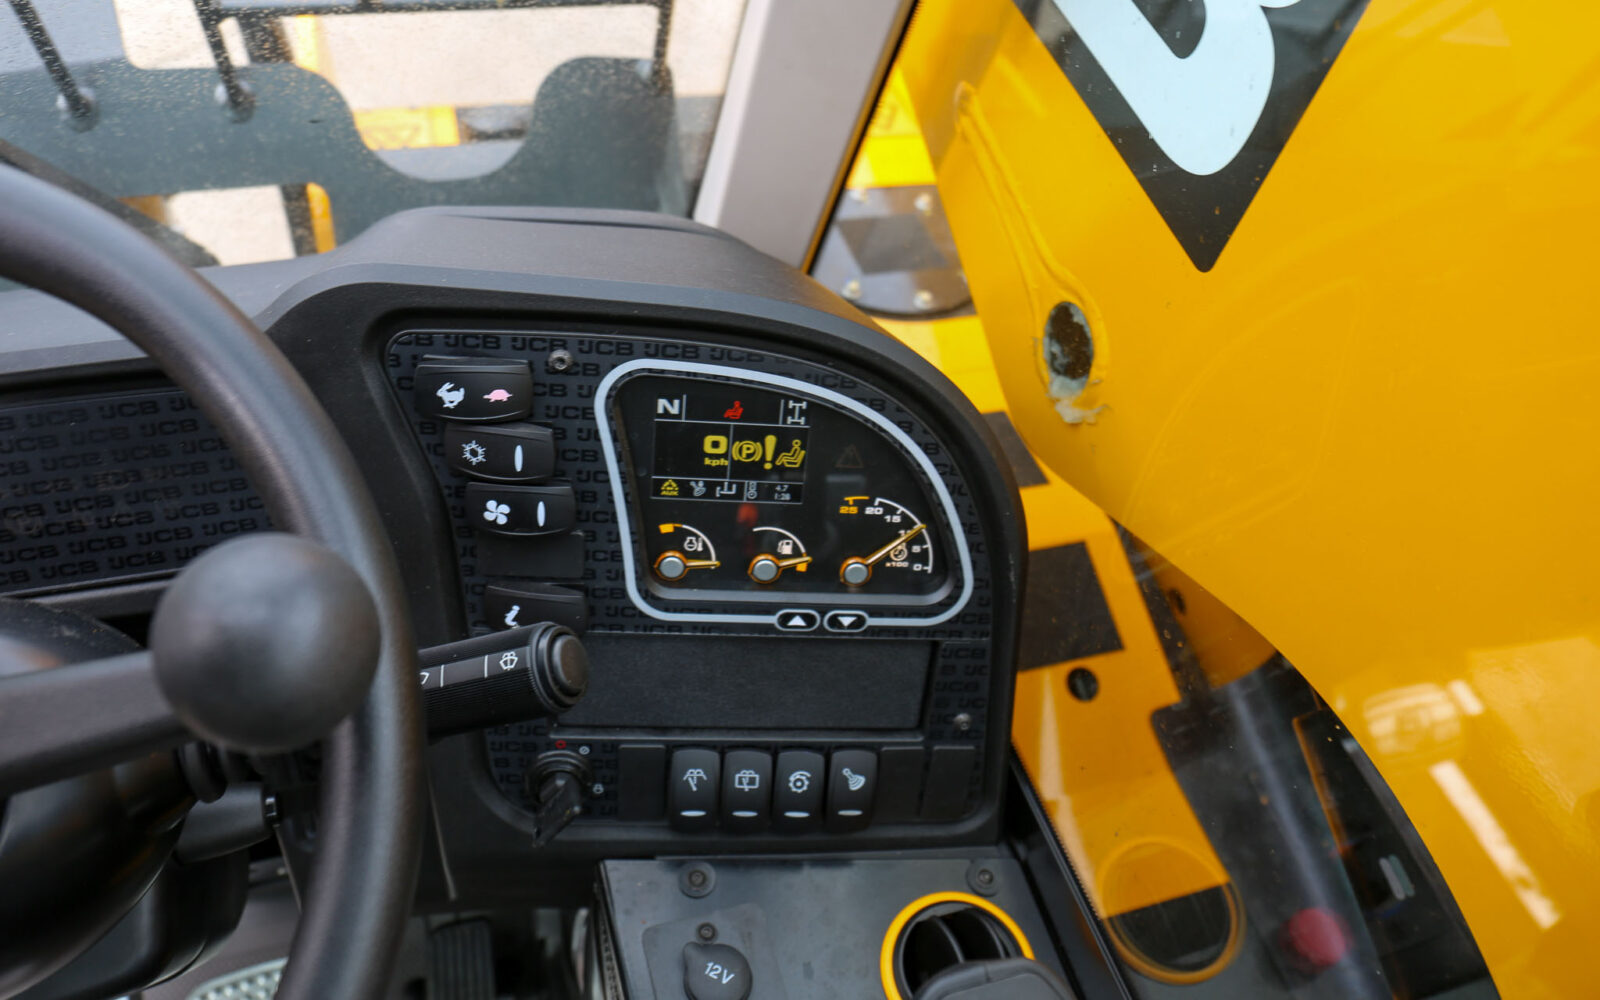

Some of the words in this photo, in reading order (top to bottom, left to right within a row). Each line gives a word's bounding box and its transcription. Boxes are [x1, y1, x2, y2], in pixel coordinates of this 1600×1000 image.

[443, 333, 501, 350] JCB
[511, 336, 569, 352] JCB
[577, 339, 635, 355] JCB
[645, 342, 699, 359] JCB
[532, 383, 569, 398] CB
[98, 400, 160, 420] JCB
[656, 399, 680, 415] N
[141, 419, 199, 438] JCB
[703, 434, 728, 455] 0
[560, 449, 599, 463] CB
[703, 457, 729, 467] kph
[577, 470, 609, 484] JC
[3, 503, 45, 521] CB
[54, 495, 115, 514] JCB
[192, 478, 249, 497] JCB
[95, 511, 154, 530] JCB
[164, 503, 220, 521] JCB
[230, 496, 264, 511] JC
[839, 506, 859, 515] 25
[864, 506, 884, 515] 20
[884, 515, 902, 523] 15
[0, 544, 58, 564] JCB
[68, 536, 127, 555] JCB
[136, 527, 193, 546] JCB
[202, 519, 258, 537] JCB
[911, 545, 922, 553] 5
[39, 560, 99, 580] JCB
[107, 550, 166, 570] JCB
[913, 563, 923, 571] 0
[941, 647, 986, 659] JCB
[935, 681, 979, 692] JCB
[958, 698, 986, 708] JC
[519, 726, 549, 736] JC
[490, 742, 537, 752] JCB
[705, 961, 735, 985] 12V
